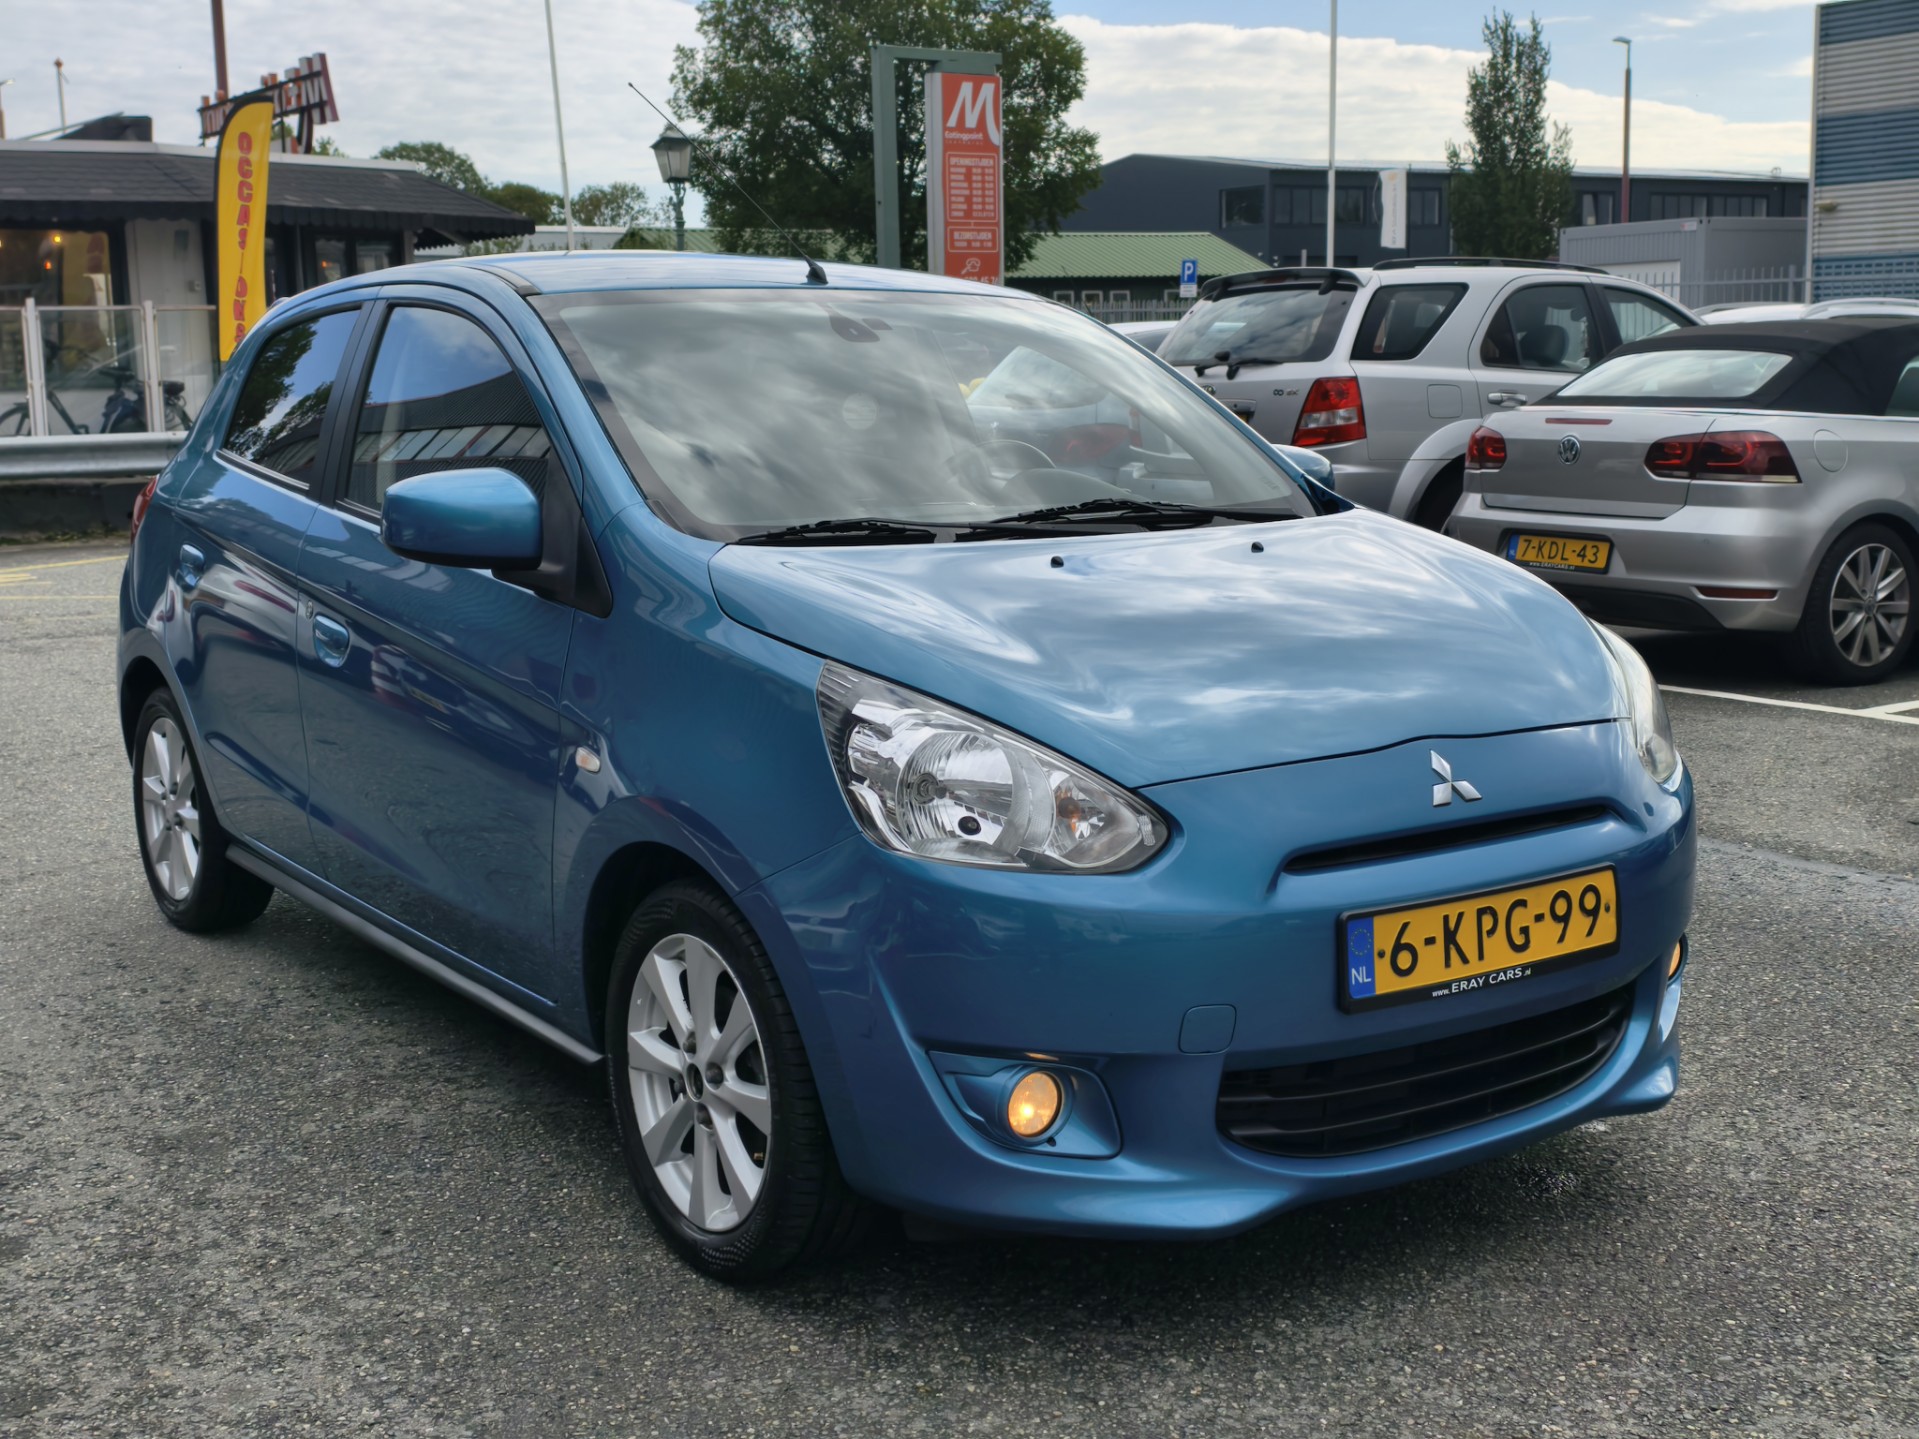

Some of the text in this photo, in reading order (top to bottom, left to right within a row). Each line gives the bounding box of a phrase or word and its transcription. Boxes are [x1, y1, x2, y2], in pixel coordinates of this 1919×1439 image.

[1521, 539, 1600, 564] 7-KDL-43
[1389, 884, 1602, 977] 6-KPG-99
[1351, 966, 1372, 985] NL
[1452, 976, 1486, 993] ERAY
[1489, 967, 1522, 984] CARS
